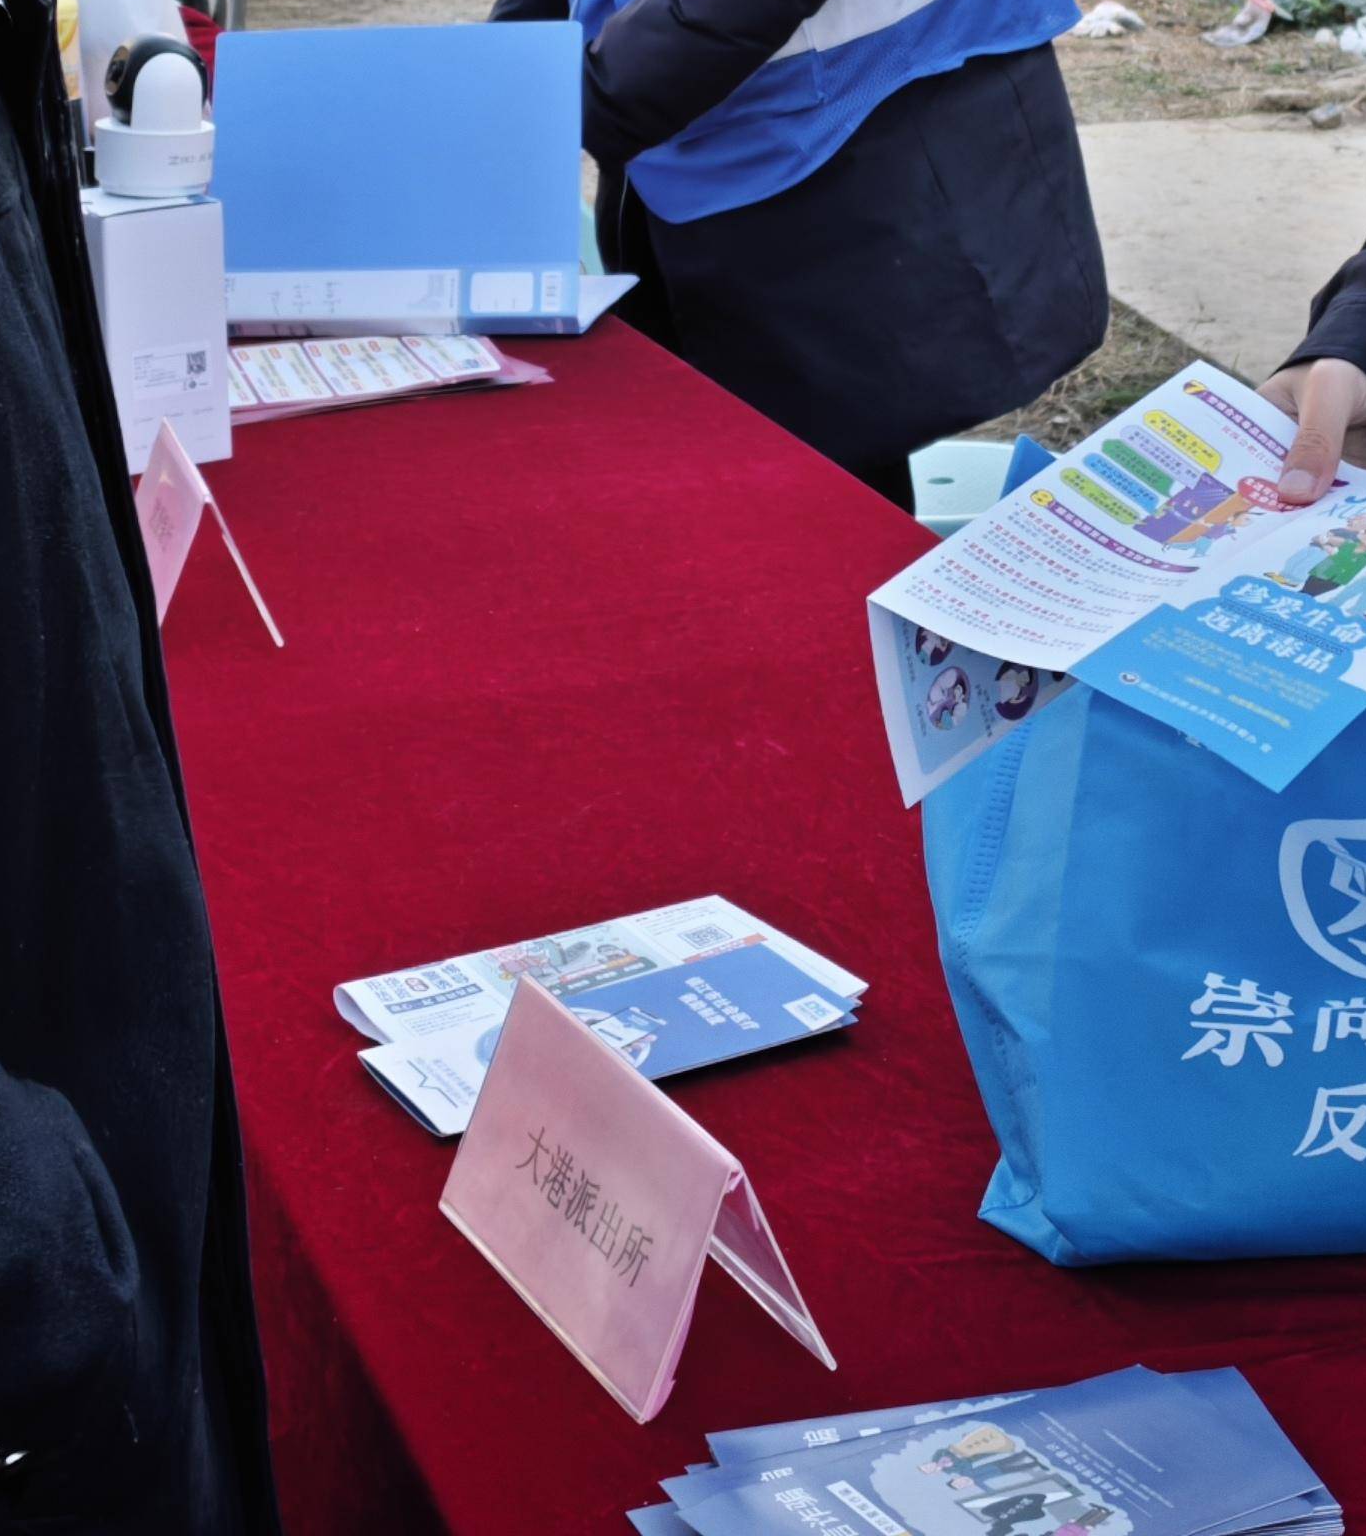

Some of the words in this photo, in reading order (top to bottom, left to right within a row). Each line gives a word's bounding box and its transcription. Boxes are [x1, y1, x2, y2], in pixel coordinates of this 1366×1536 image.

[1196, 605, 1335, 675] 远离毒品
[515, 1126, 654, 1288] 大港派出所
